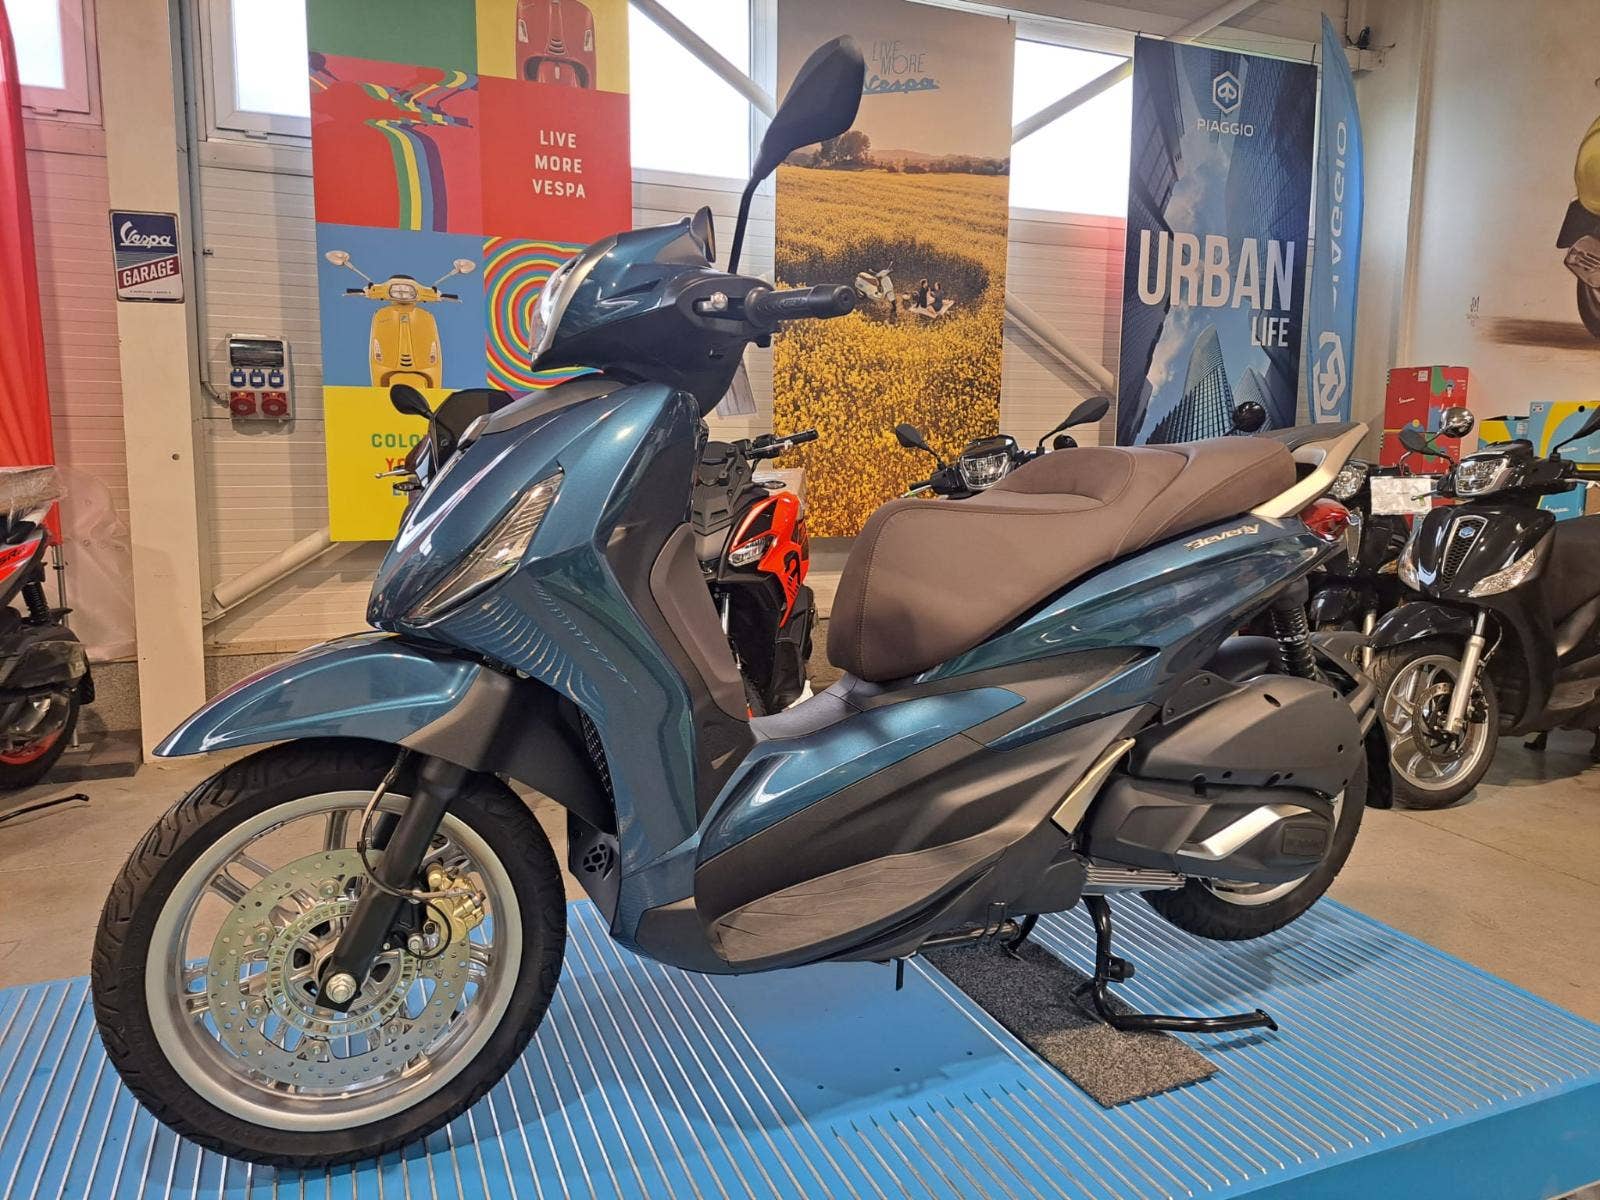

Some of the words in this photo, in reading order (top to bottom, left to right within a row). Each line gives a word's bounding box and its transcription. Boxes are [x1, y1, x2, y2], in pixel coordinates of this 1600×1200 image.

[881, 52, 927, 75] MORE
[540, 129, 577, 148] LIVE
[1197, 118, 1254, 137] PIAGGIO
[535, 154, 582, 174] MORE
[532, 179, 586, 198] VESPA
[120, 221, 175, 248] Vespa
[122, 260, 175, 287] GARAGE
[1137, 229, 1295, 311] URBAN
[1251, 317, 1290, 347] LIFE
[1183, 524, 1260, 551] Beverly
